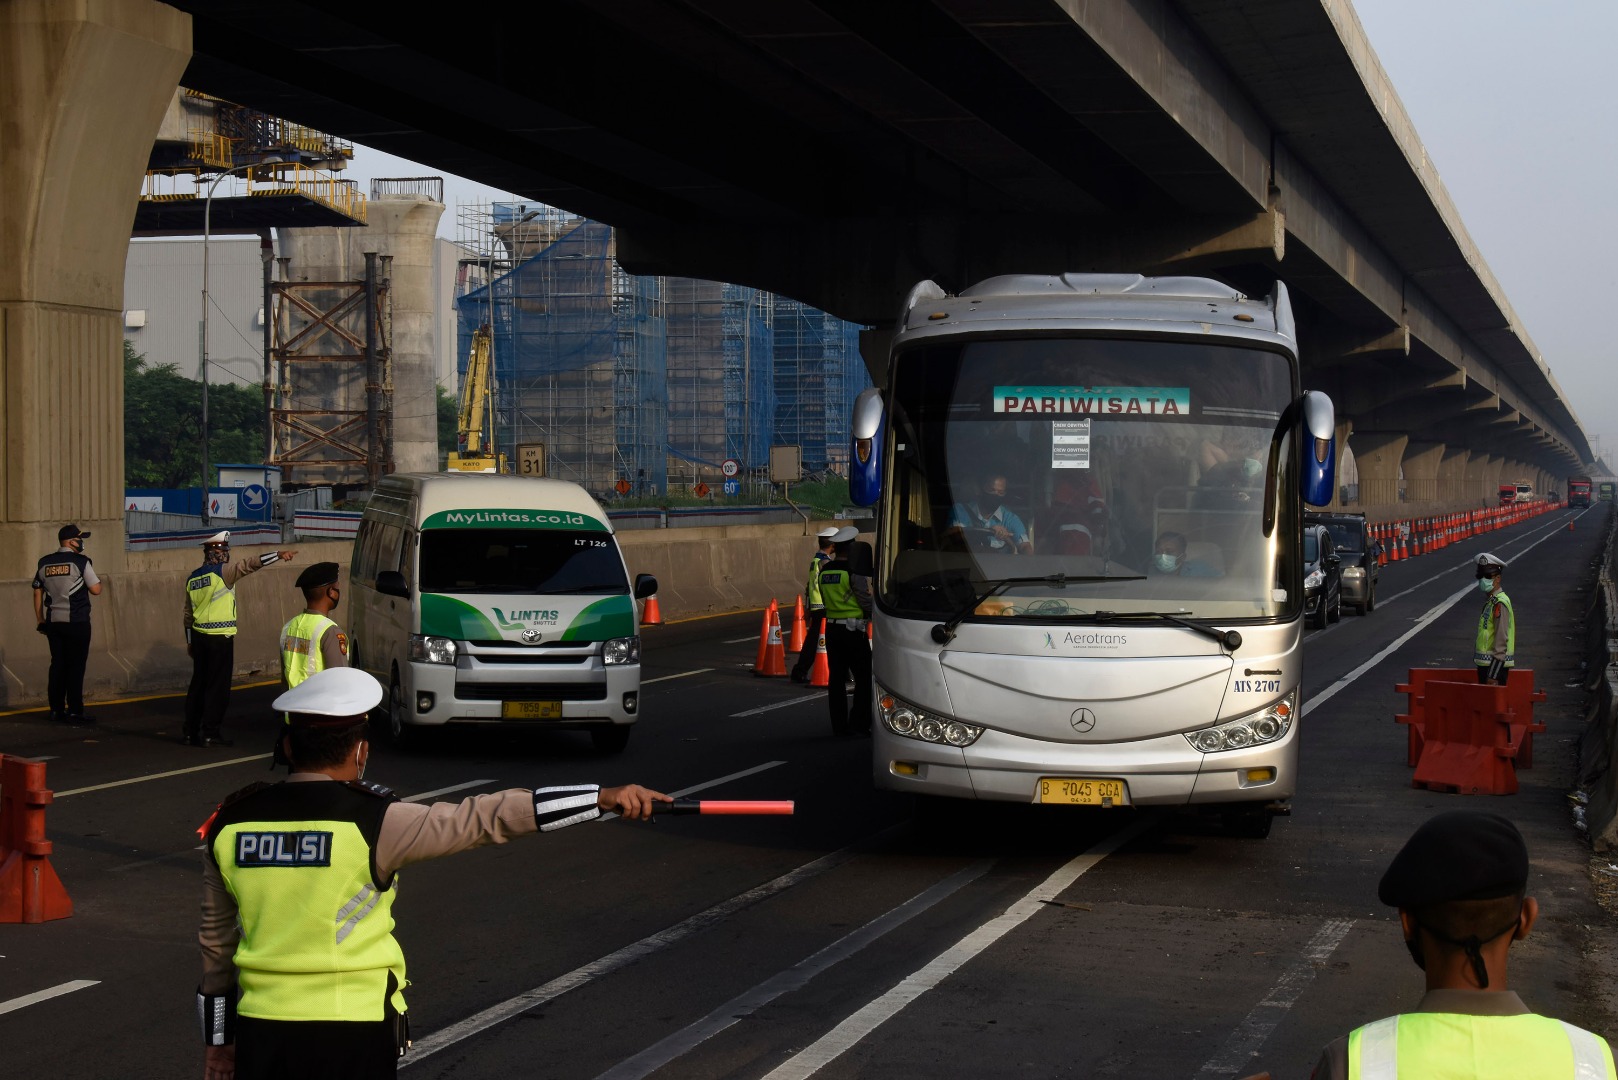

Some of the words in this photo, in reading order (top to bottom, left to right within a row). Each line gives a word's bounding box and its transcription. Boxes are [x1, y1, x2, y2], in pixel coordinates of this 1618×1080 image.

[1004, 396, 1180, 415] PARIWISATA
[523, 459, 540, 474] 31
[724, 482, 735, 494] 60
[446, 512, 584, 525] MyLintas.co.id
[589, 540, 607, 548] 126
[45, 565, 70, 576] DISHUB
[190, 576, 211, 590] POLSI
[510, 610, 559, 621] LINTAS
[1063, 632, 1127, 645] Aerotrans
[1234, 680, 1251, 692] ATS
[1254, 680, 1281, 692] 2707
[518, 702, 540, 713] 7859
[1042, 781, 1050, 795] B
[1063, 781, 1092, 796] 7045
[239, 834, 326, 862] POLISI
